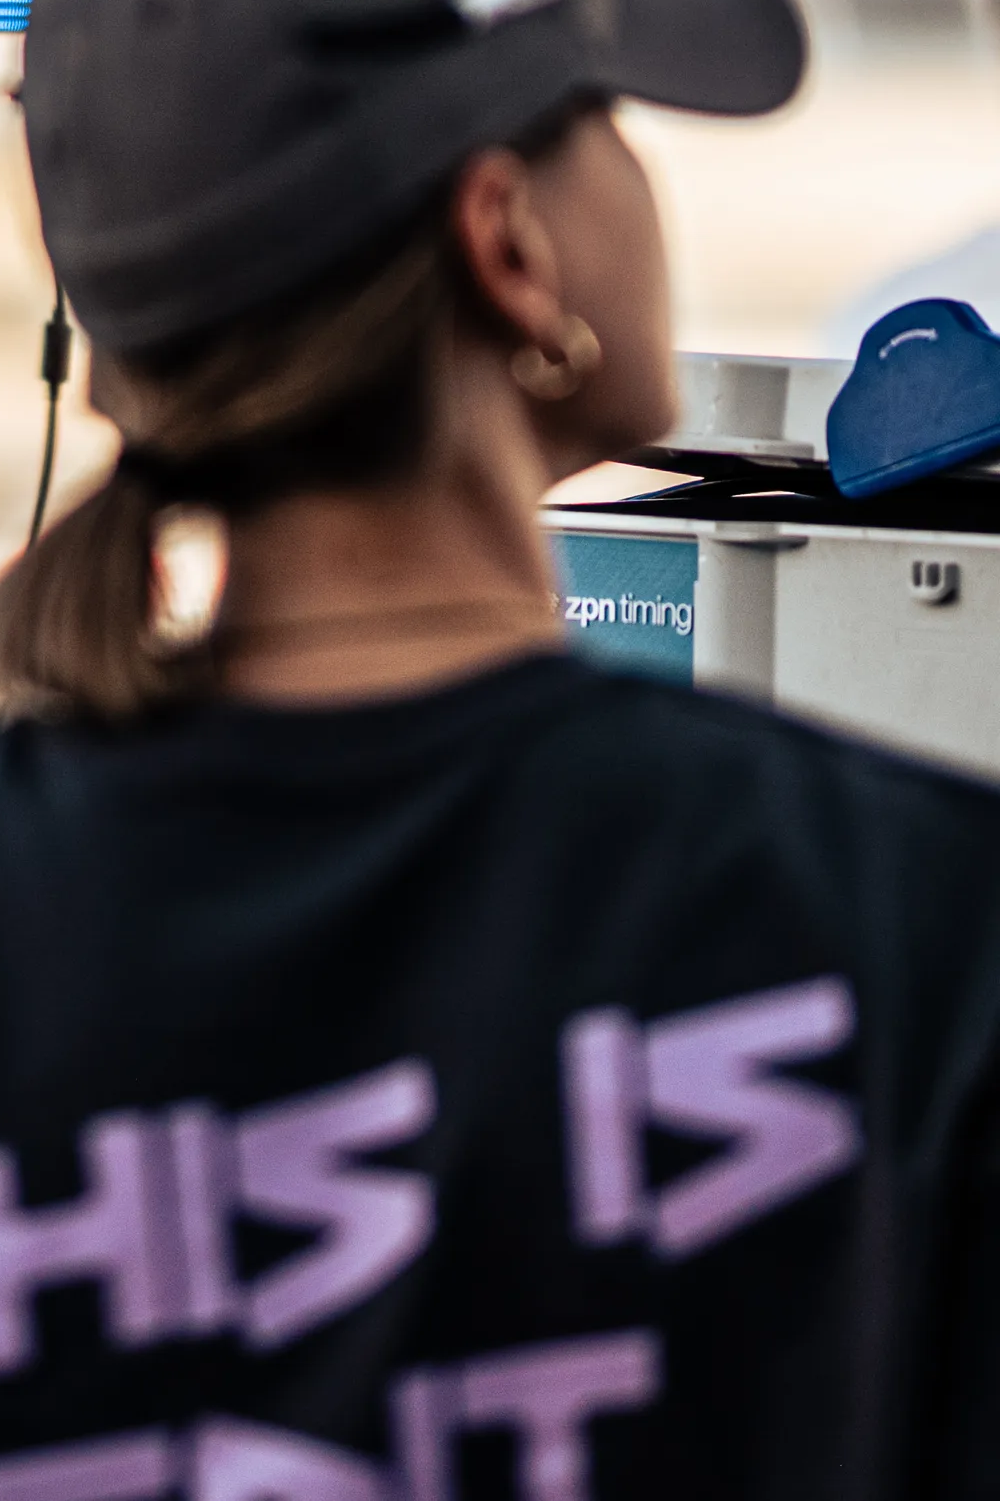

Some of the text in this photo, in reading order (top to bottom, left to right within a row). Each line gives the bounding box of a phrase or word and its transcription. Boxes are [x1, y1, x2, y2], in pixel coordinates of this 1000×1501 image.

[565, 592, 693, 636] zpn timing
[563, 973, 861, 1258] IS
